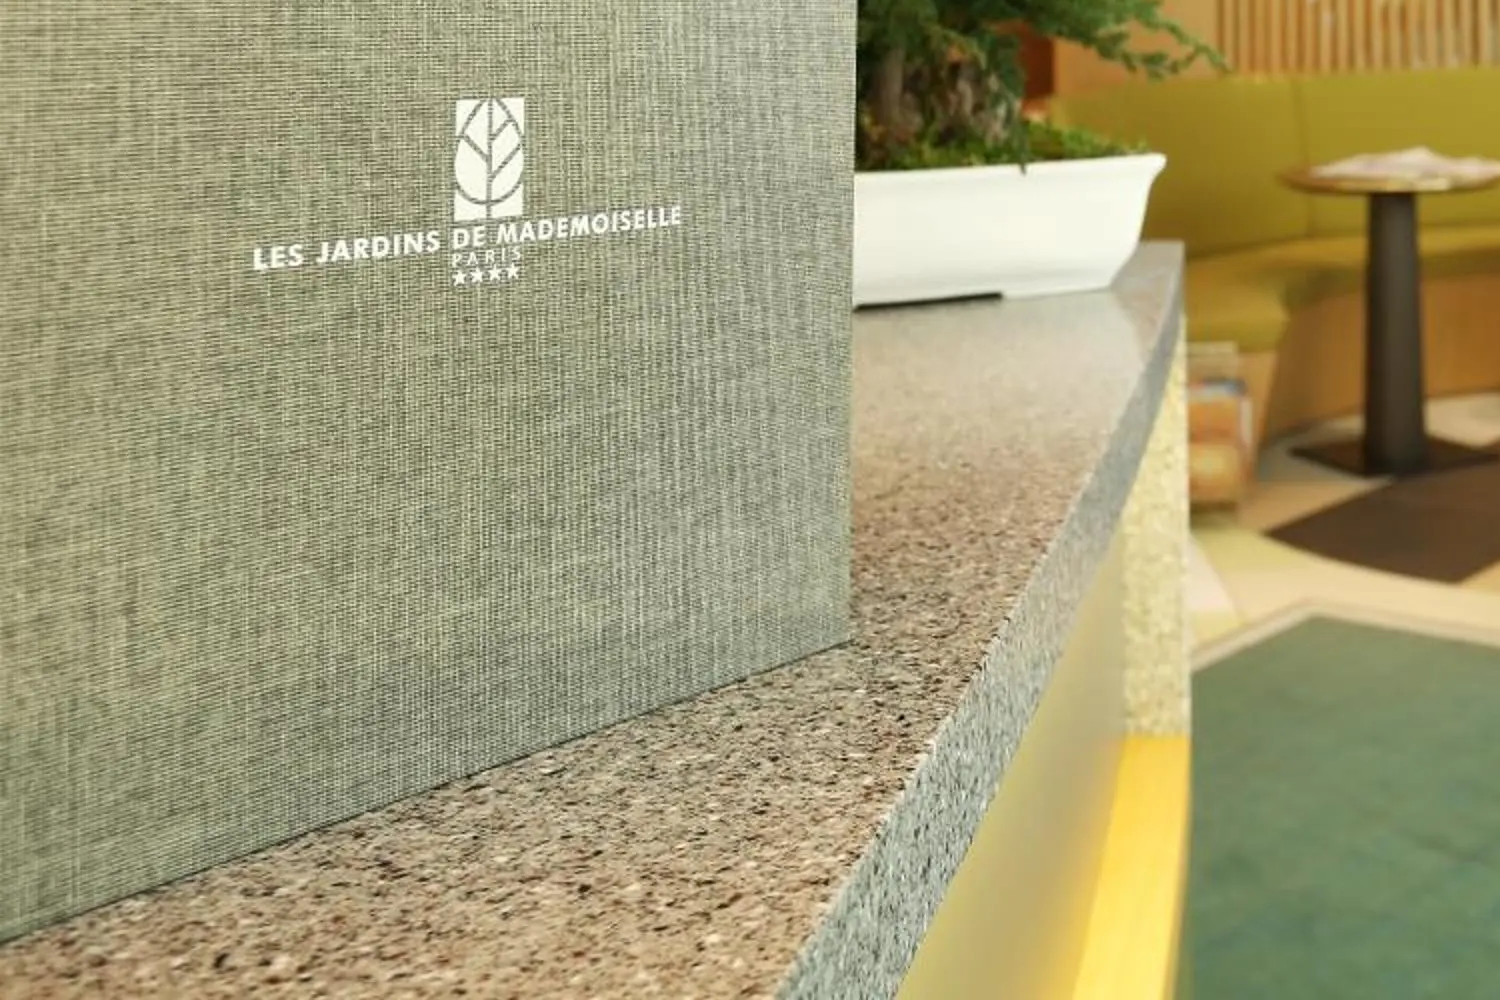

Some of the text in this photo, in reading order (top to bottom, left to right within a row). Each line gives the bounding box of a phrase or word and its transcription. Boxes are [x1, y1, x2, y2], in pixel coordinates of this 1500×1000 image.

[253, 205, 682, 271] LES JARDINS DE MADEMOISELLE
[452, 246, 522, 268] PARIS
